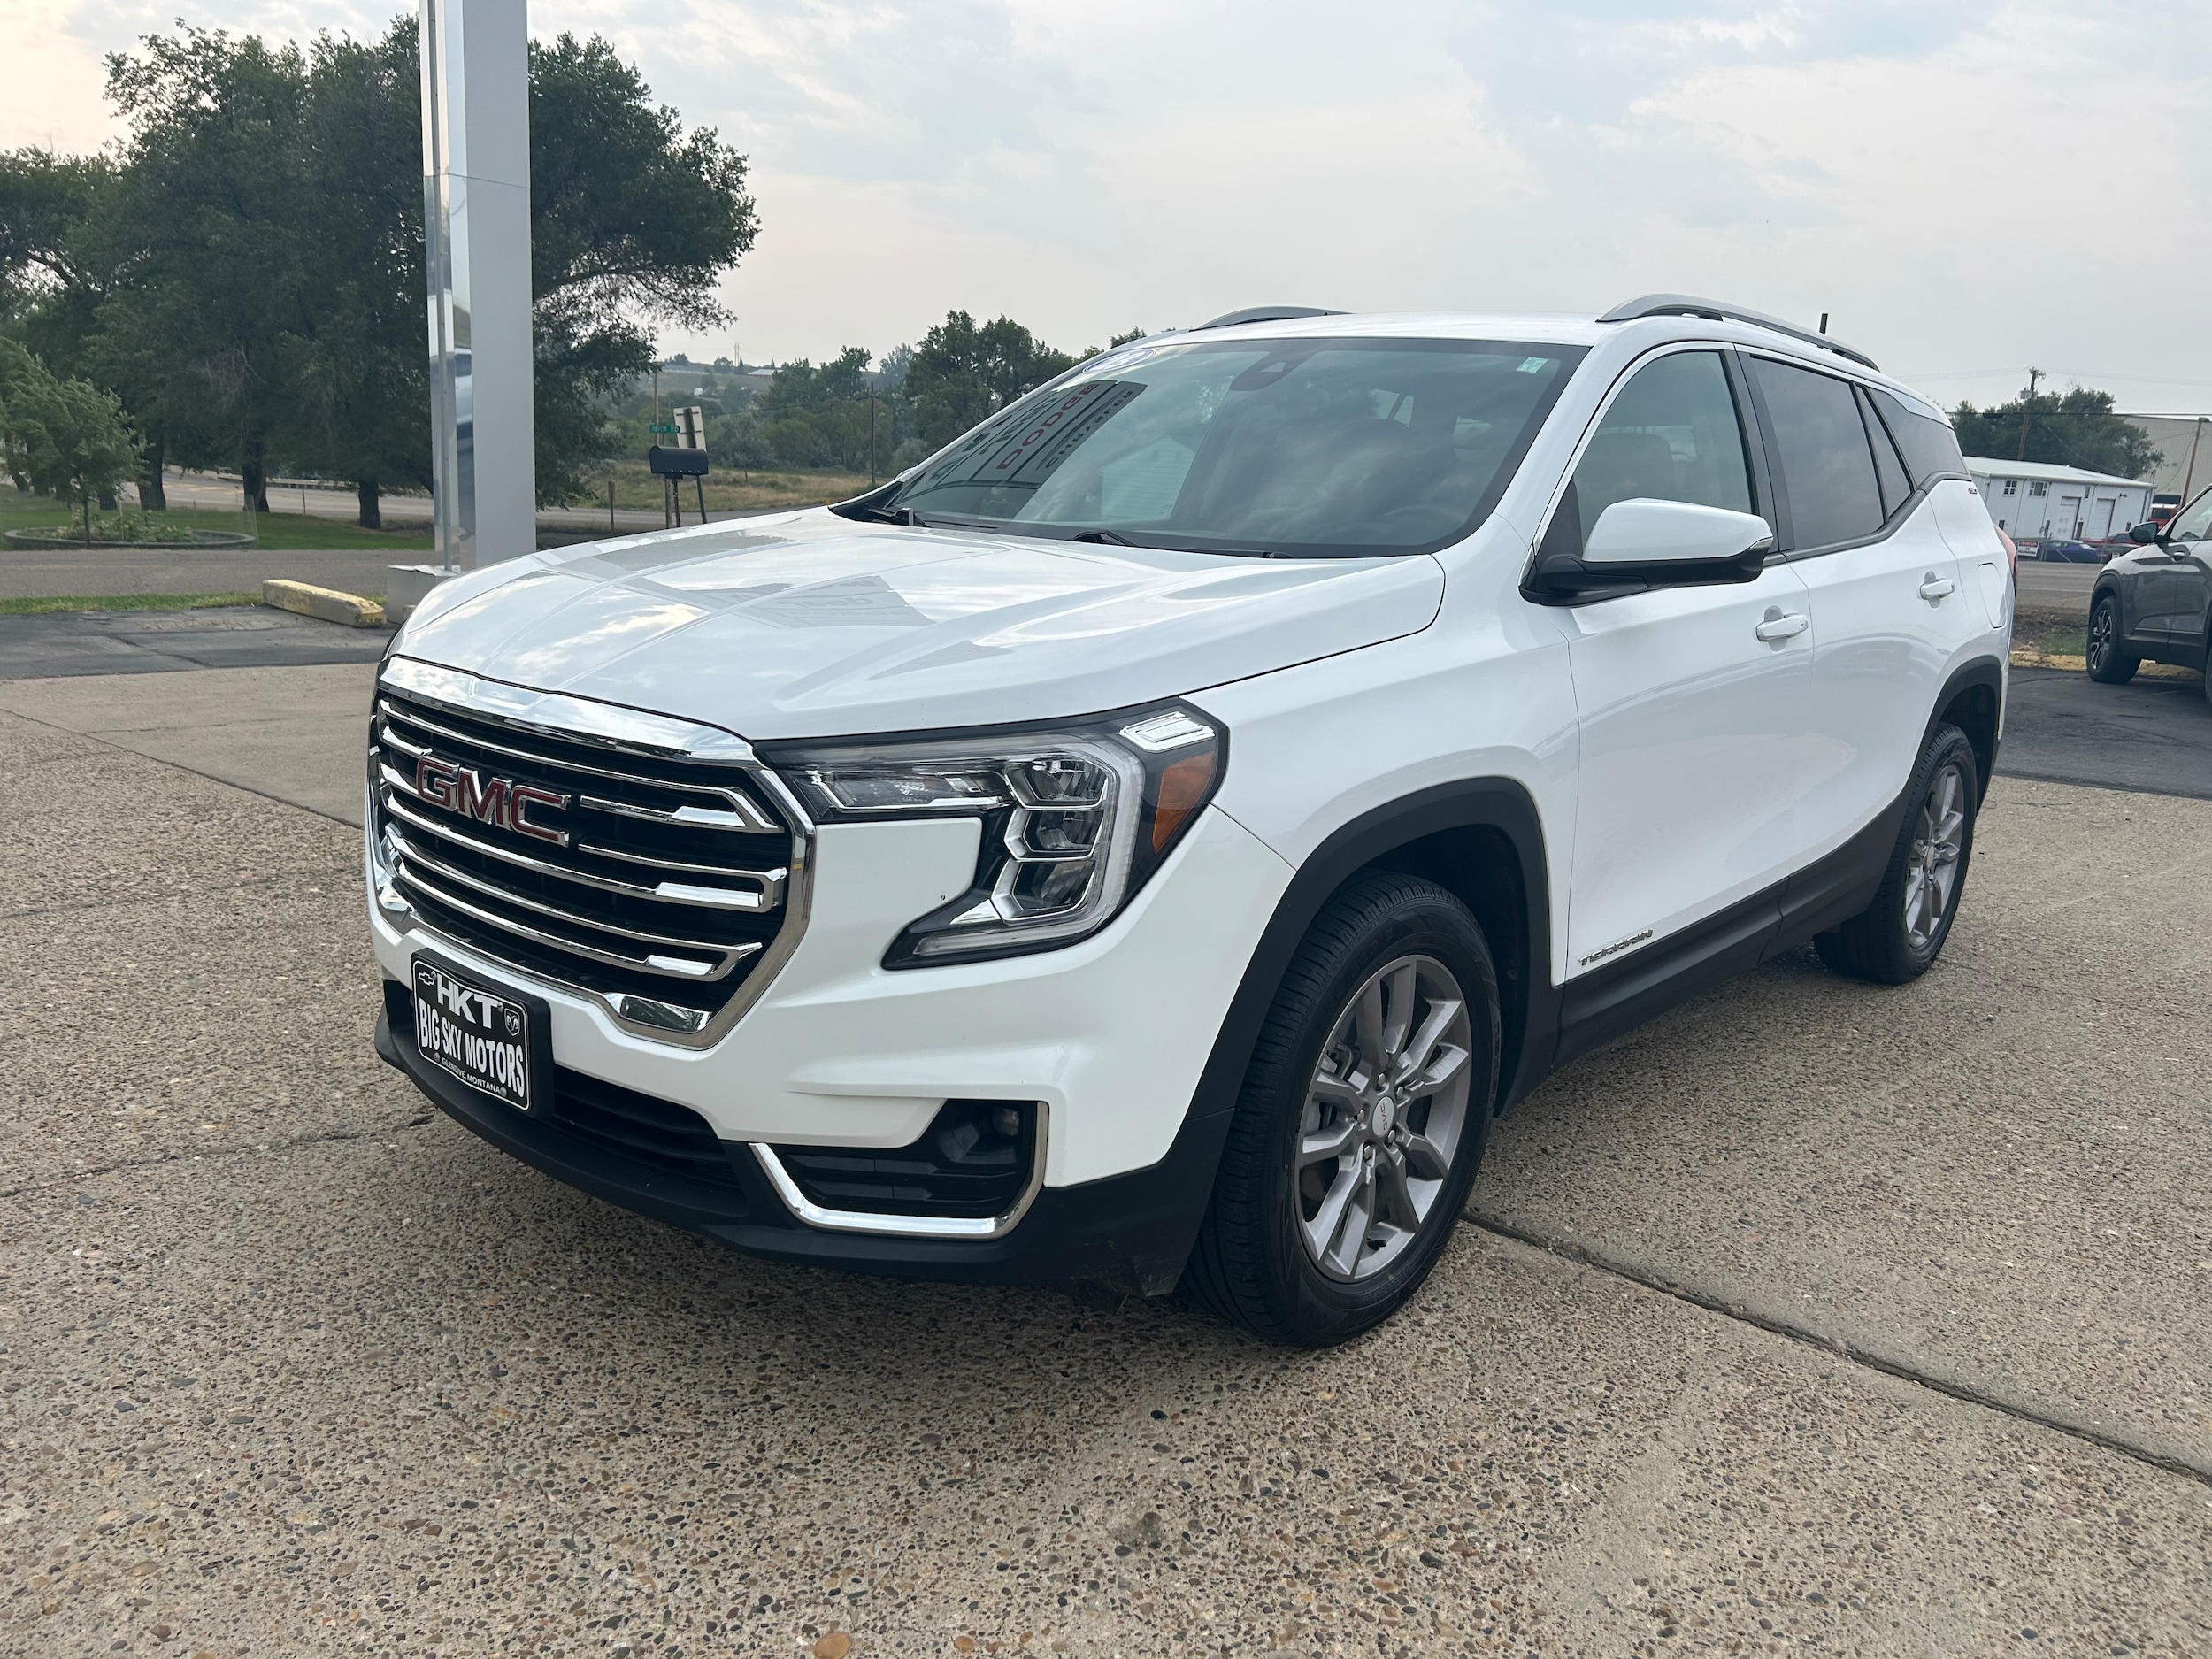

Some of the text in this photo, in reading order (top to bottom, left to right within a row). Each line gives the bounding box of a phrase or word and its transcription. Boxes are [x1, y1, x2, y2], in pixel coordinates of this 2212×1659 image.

[417, 755, 572, 848] GMC
[1578, 928, 1654, 966] TERRAIN
[436, 973, 499, 1030] HKT
[419, 997, 525, 1098] BIG SKY MOTORS
[467, 1073, 500, 1095] MONTANA
